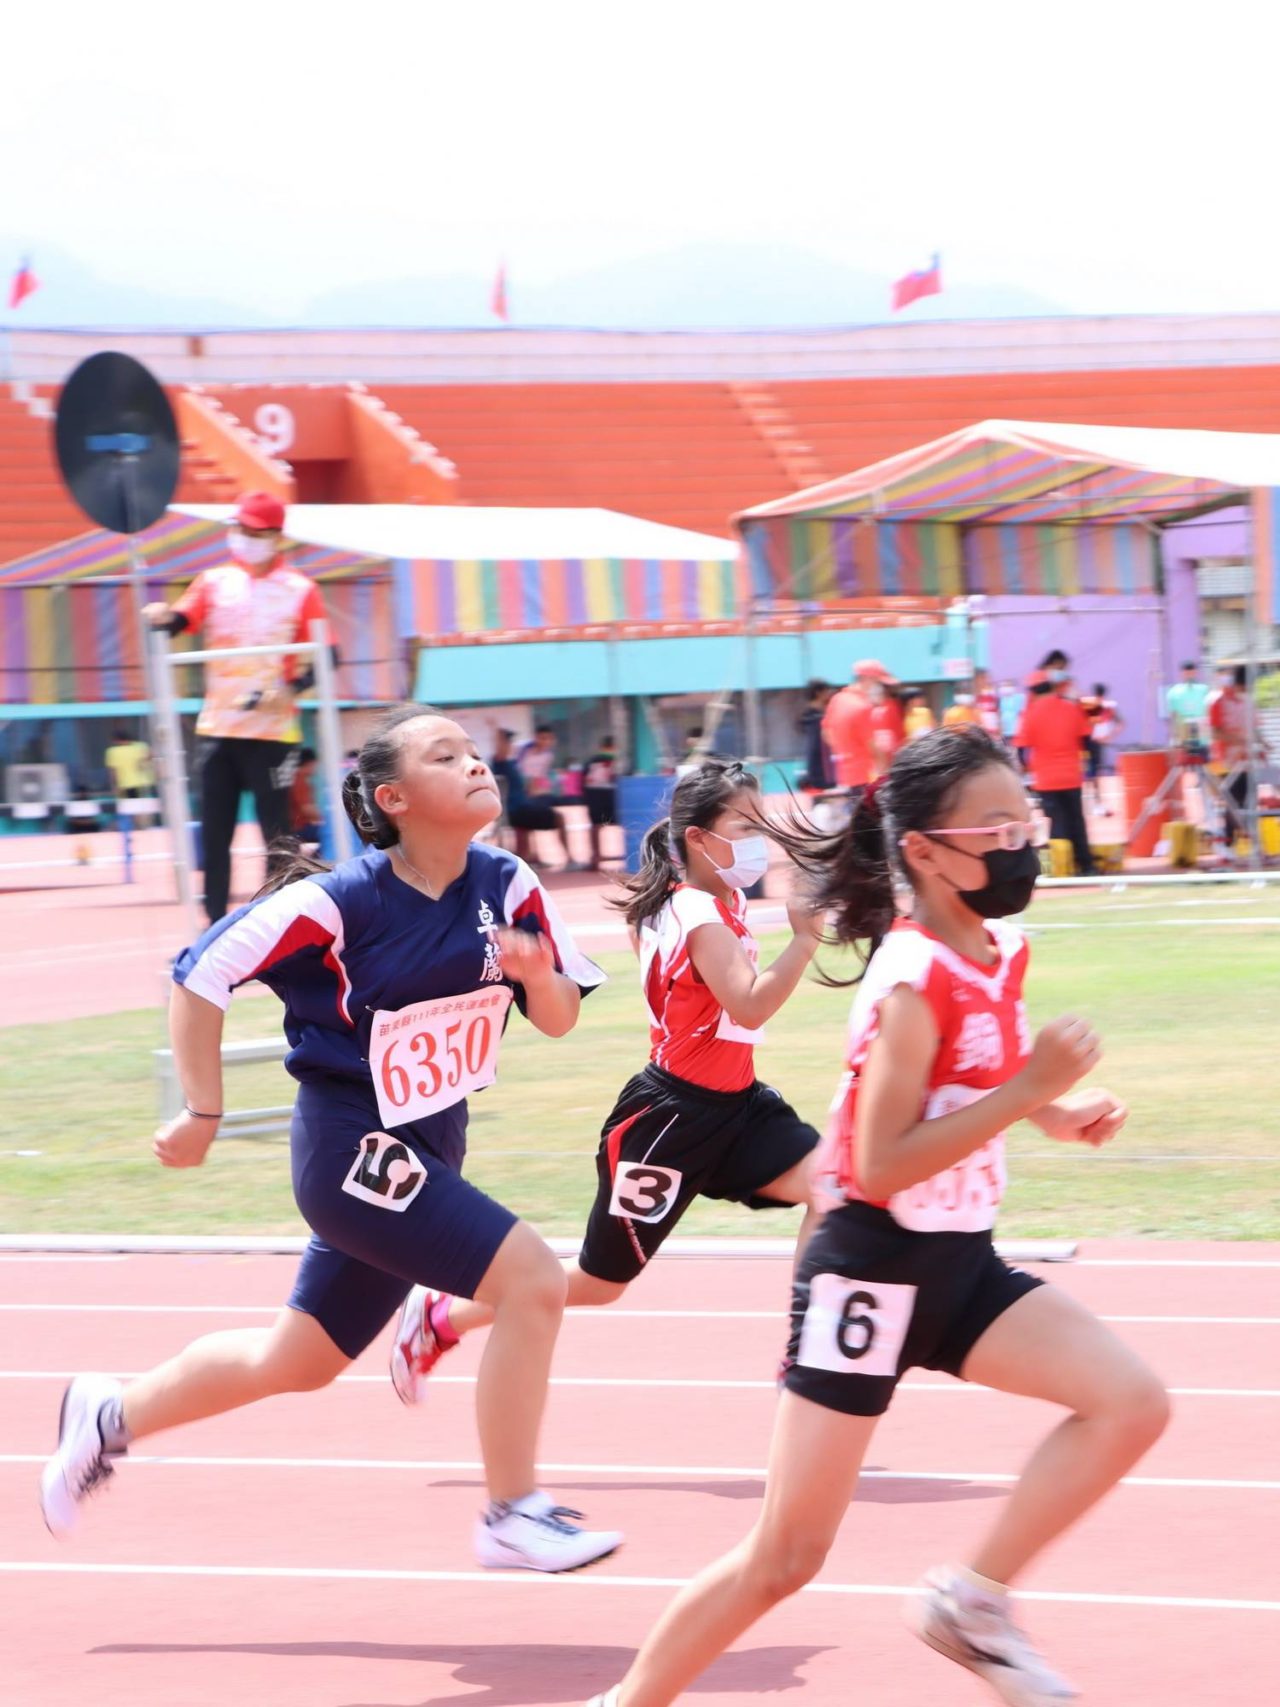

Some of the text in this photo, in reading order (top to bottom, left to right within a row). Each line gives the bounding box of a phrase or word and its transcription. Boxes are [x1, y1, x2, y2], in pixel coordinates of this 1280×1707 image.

[255, 403, 295, 453] 9
[382, 1016, 491, 1107] 6350
[353, 1138, 421, 1200] 5
[619, 1168, 672, 1217] 3
[837, 1290, 878, 1360] 6
